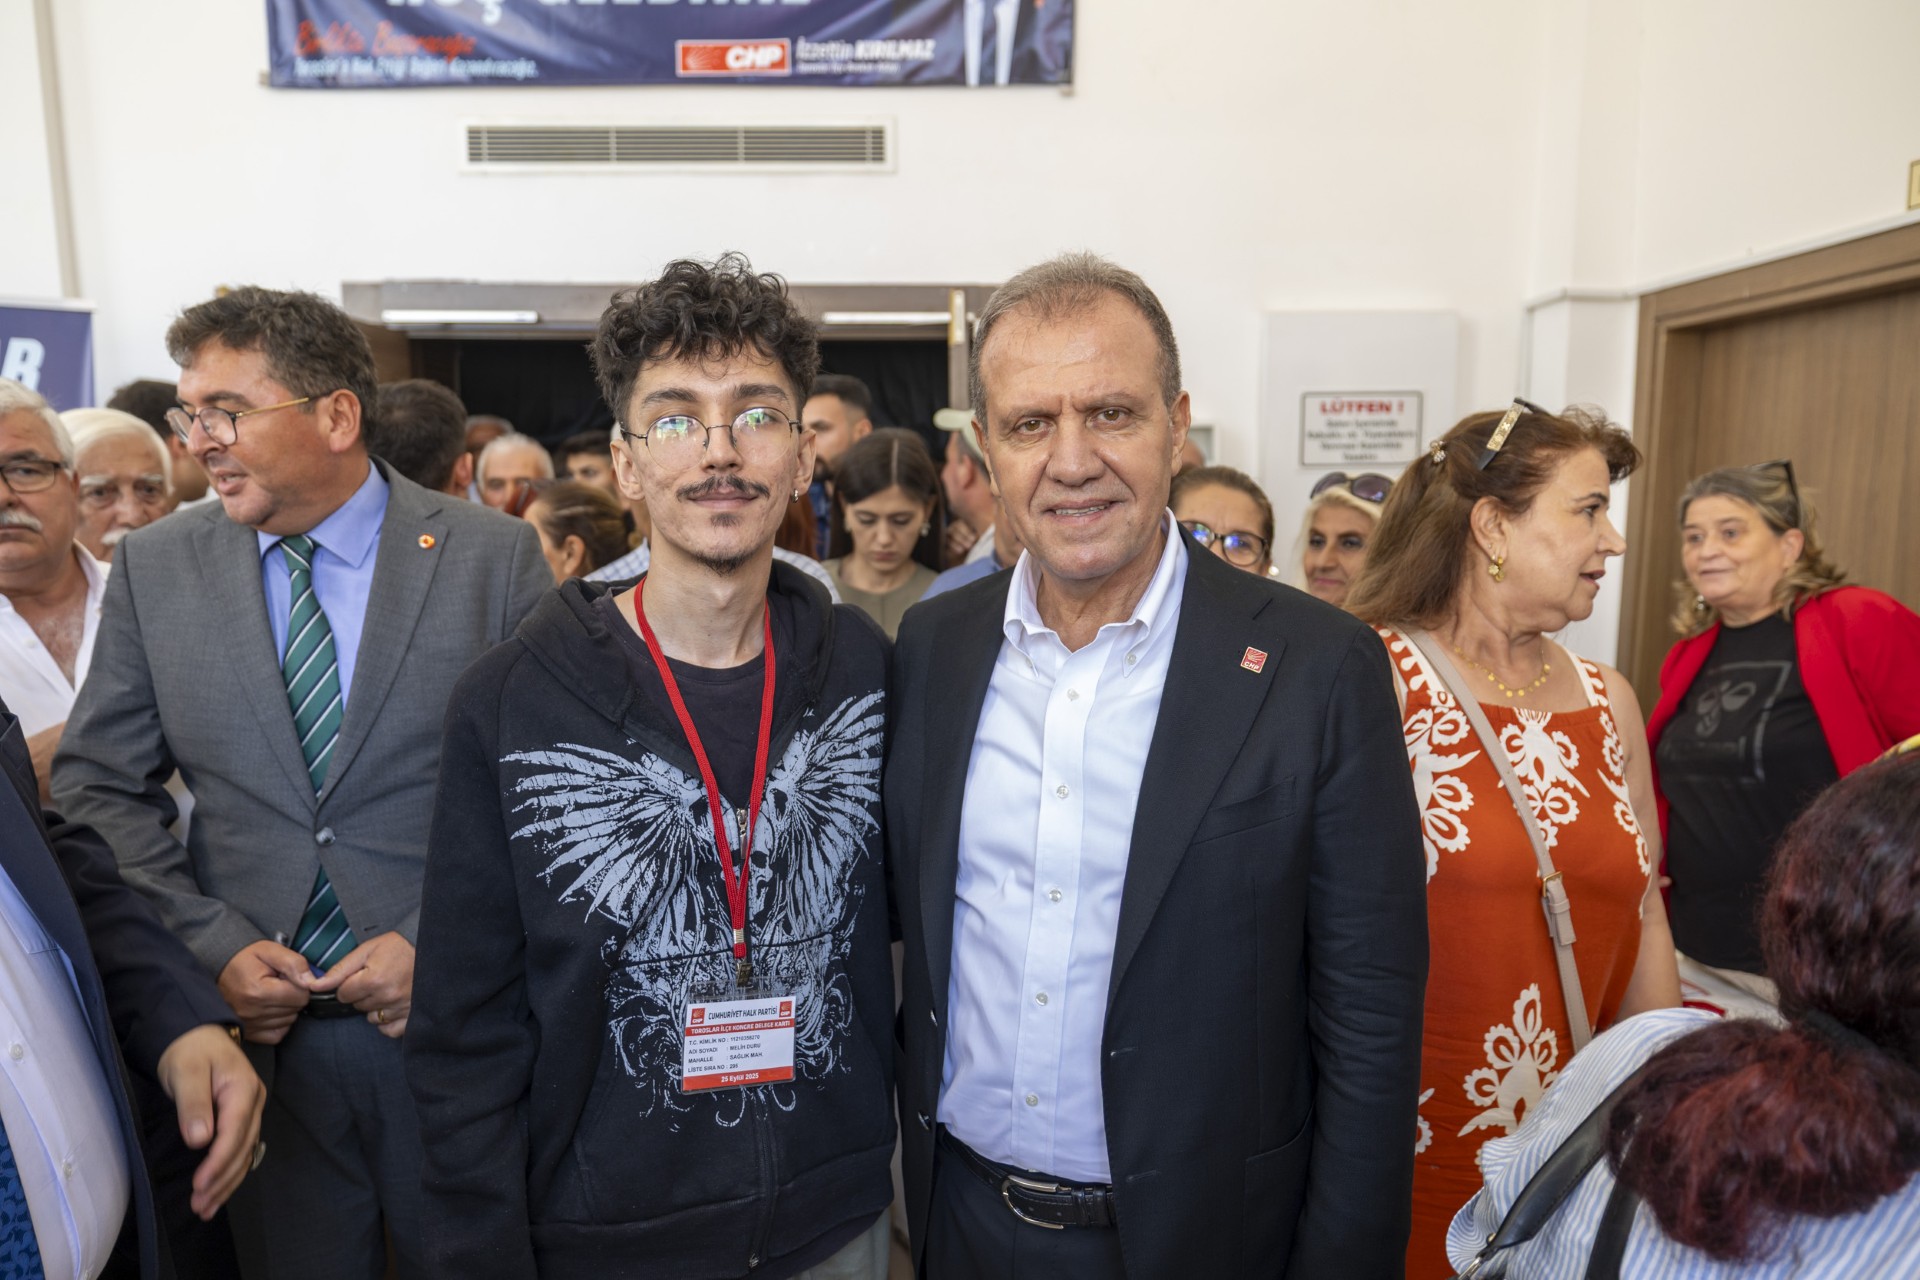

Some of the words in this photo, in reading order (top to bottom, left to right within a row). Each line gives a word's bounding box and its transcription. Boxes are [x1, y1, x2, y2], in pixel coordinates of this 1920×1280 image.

[724, 45, 784, 69] CHP
[1320, 398, 1392, 415] LÜTFEN
[1244, 661, 1260, 671] CHP
[708, 1009, 742, 1020] CUMHURİYET
[743, 1009, 757, 1017] HALK
[758, 1006, 777, 1015] PARTİSİ
[720, 1024, 731, 1032] İLÇE
[732, 1023, 754, 1031] KONGRE
[688, 1056, 714, 1064] MAHALLE
[721, 1075, 729, 1083] 25
[729, 1074, 745, 1082] Eylül
[745, 1072, 759, 1080] 2025
